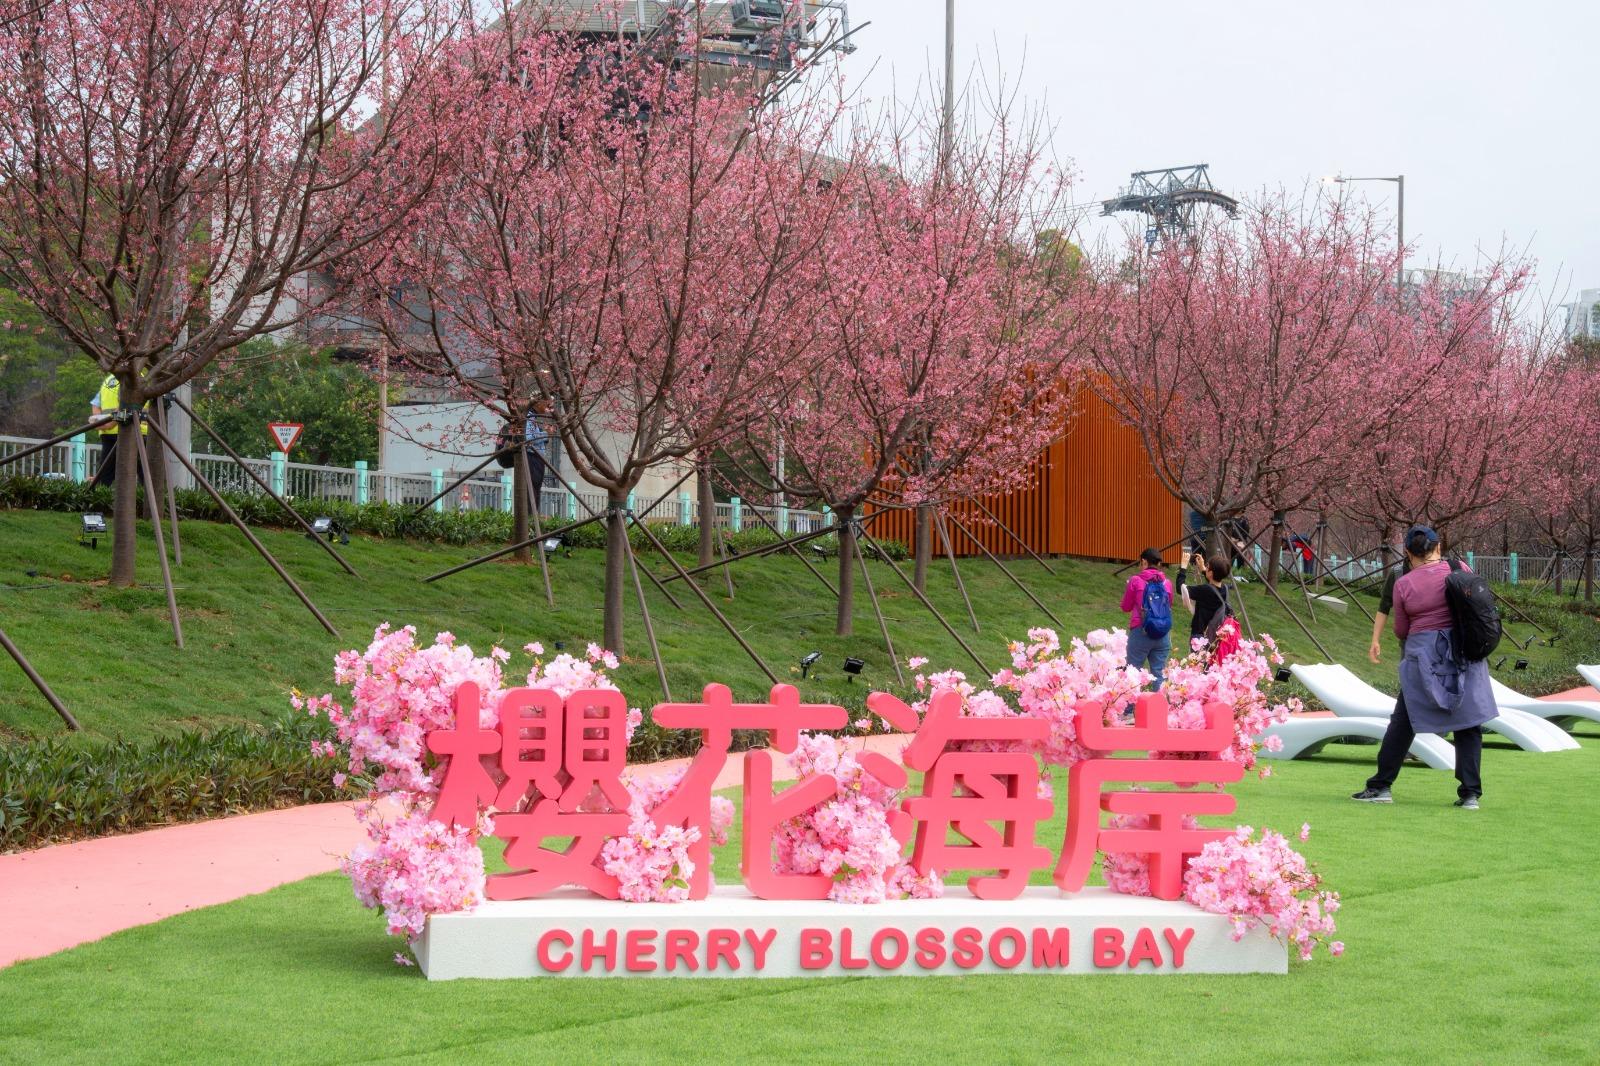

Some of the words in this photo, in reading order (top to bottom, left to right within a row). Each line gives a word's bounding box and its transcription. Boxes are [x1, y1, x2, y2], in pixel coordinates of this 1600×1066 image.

[427, 680, 1244, 900] 櫻花海岸
[537, 928, 777, 972] CHERRY
[799, 928, 1070, 969] BLOSSOM
[1093, 927, 1195, 968] BAY
